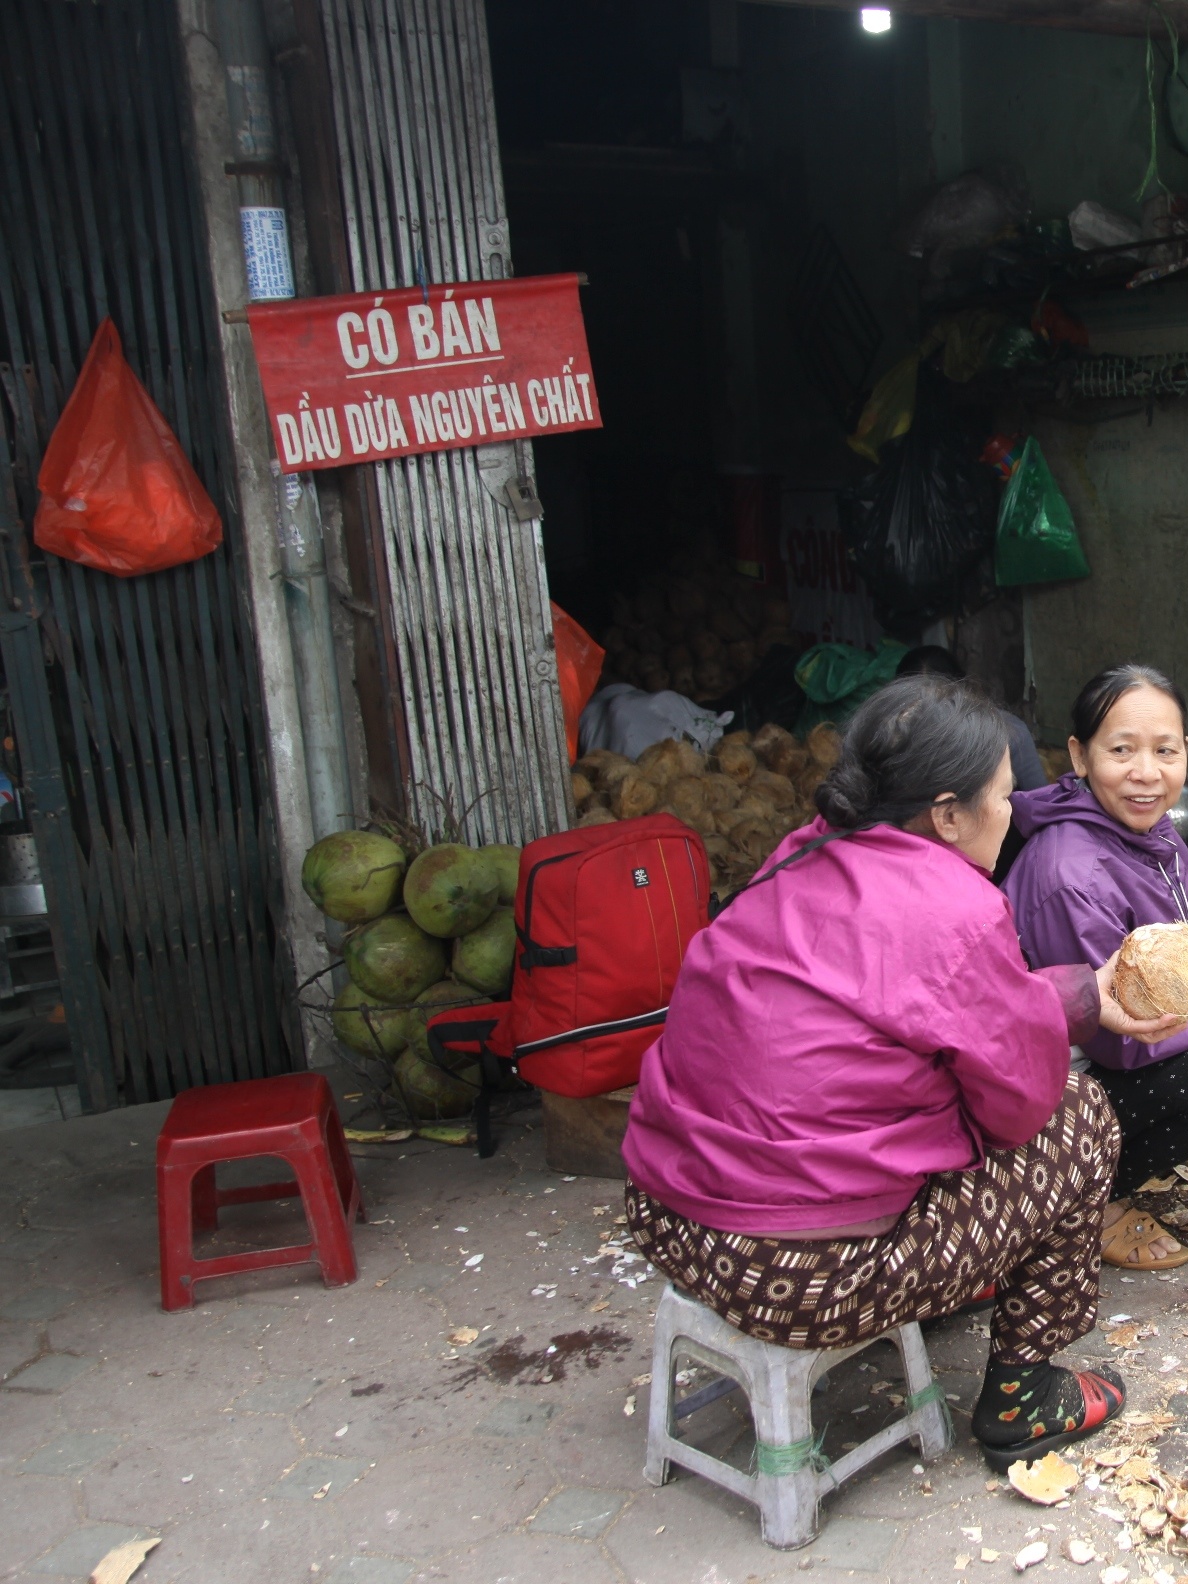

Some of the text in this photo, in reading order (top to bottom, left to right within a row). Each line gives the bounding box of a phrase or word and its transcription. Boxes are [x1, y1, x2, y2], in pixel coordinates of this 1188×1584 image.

[336, 290, 501, 369] CÓ BÁN
[276, 357, 594, 465] DẦU DỪA NGUYÊN CHẤT
